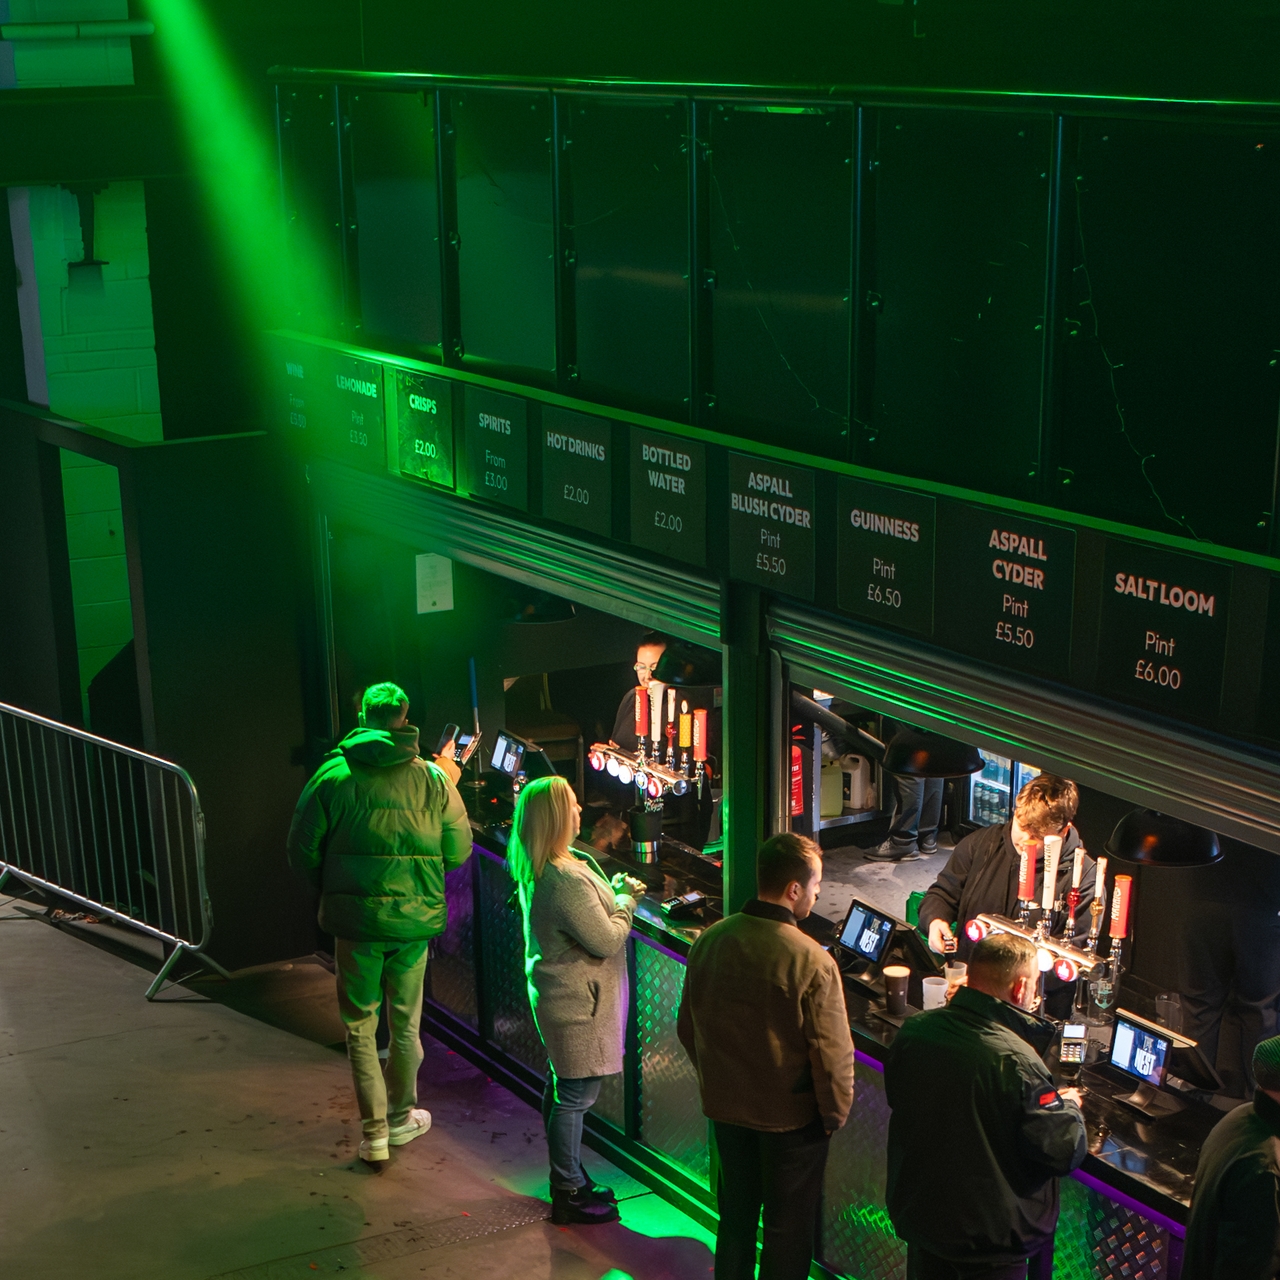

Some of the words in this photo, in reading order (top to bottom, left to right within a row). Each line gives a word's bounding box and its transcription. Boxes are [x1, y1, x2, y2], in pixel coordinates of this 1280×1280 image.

[336, 375, 378, 398] LEMONADE
[409, 393, 437, 414] CRISPS
[479, 412, 511, 434] SPIRITS
[414, 439, 436, 458] £2.00
[546, 431, 569, 451] HOT
[569, 437, 605, 461] DRINKS
[642, 444, 691, 471] BOTTLED
[485, 450, 506, 468] From
[485, 472, 508, 491] £3.00
[648, 471, 685, 495] WATER
[748, 472, 792, 497] ASPALL
[563, 485, 590, 505] £2.00
[654, 512, 683, 533] £2.00
[731, 492, 769, 519] BLUSH
[769, 501, 810, 528] CYDER
[850, 509, 920, 541] GUINNESS
[760, 529, 780, 548] Pint
[989, 529, 1048, 561] ASPALL
[756, 553, 786, 575] £5.50
[872, 558, 896, 579] Pint
[991, 559, 1044, 590] CYDER
[866, 584, 902, 608] £6.50
[1002, 594, 1029, 619] Pint
[1114, 572, 1159, 603] SALT
[1158, 581, 1215, 617] LOOM
[995, 621, 1034, 649] £5.50
[1145, 631, 1176, 657] Pint
[1134, 659, 1181, 691] £6.00
[859, 928, 880, 953] NEST
[1134, 1047, 1156, 1076] NEST
